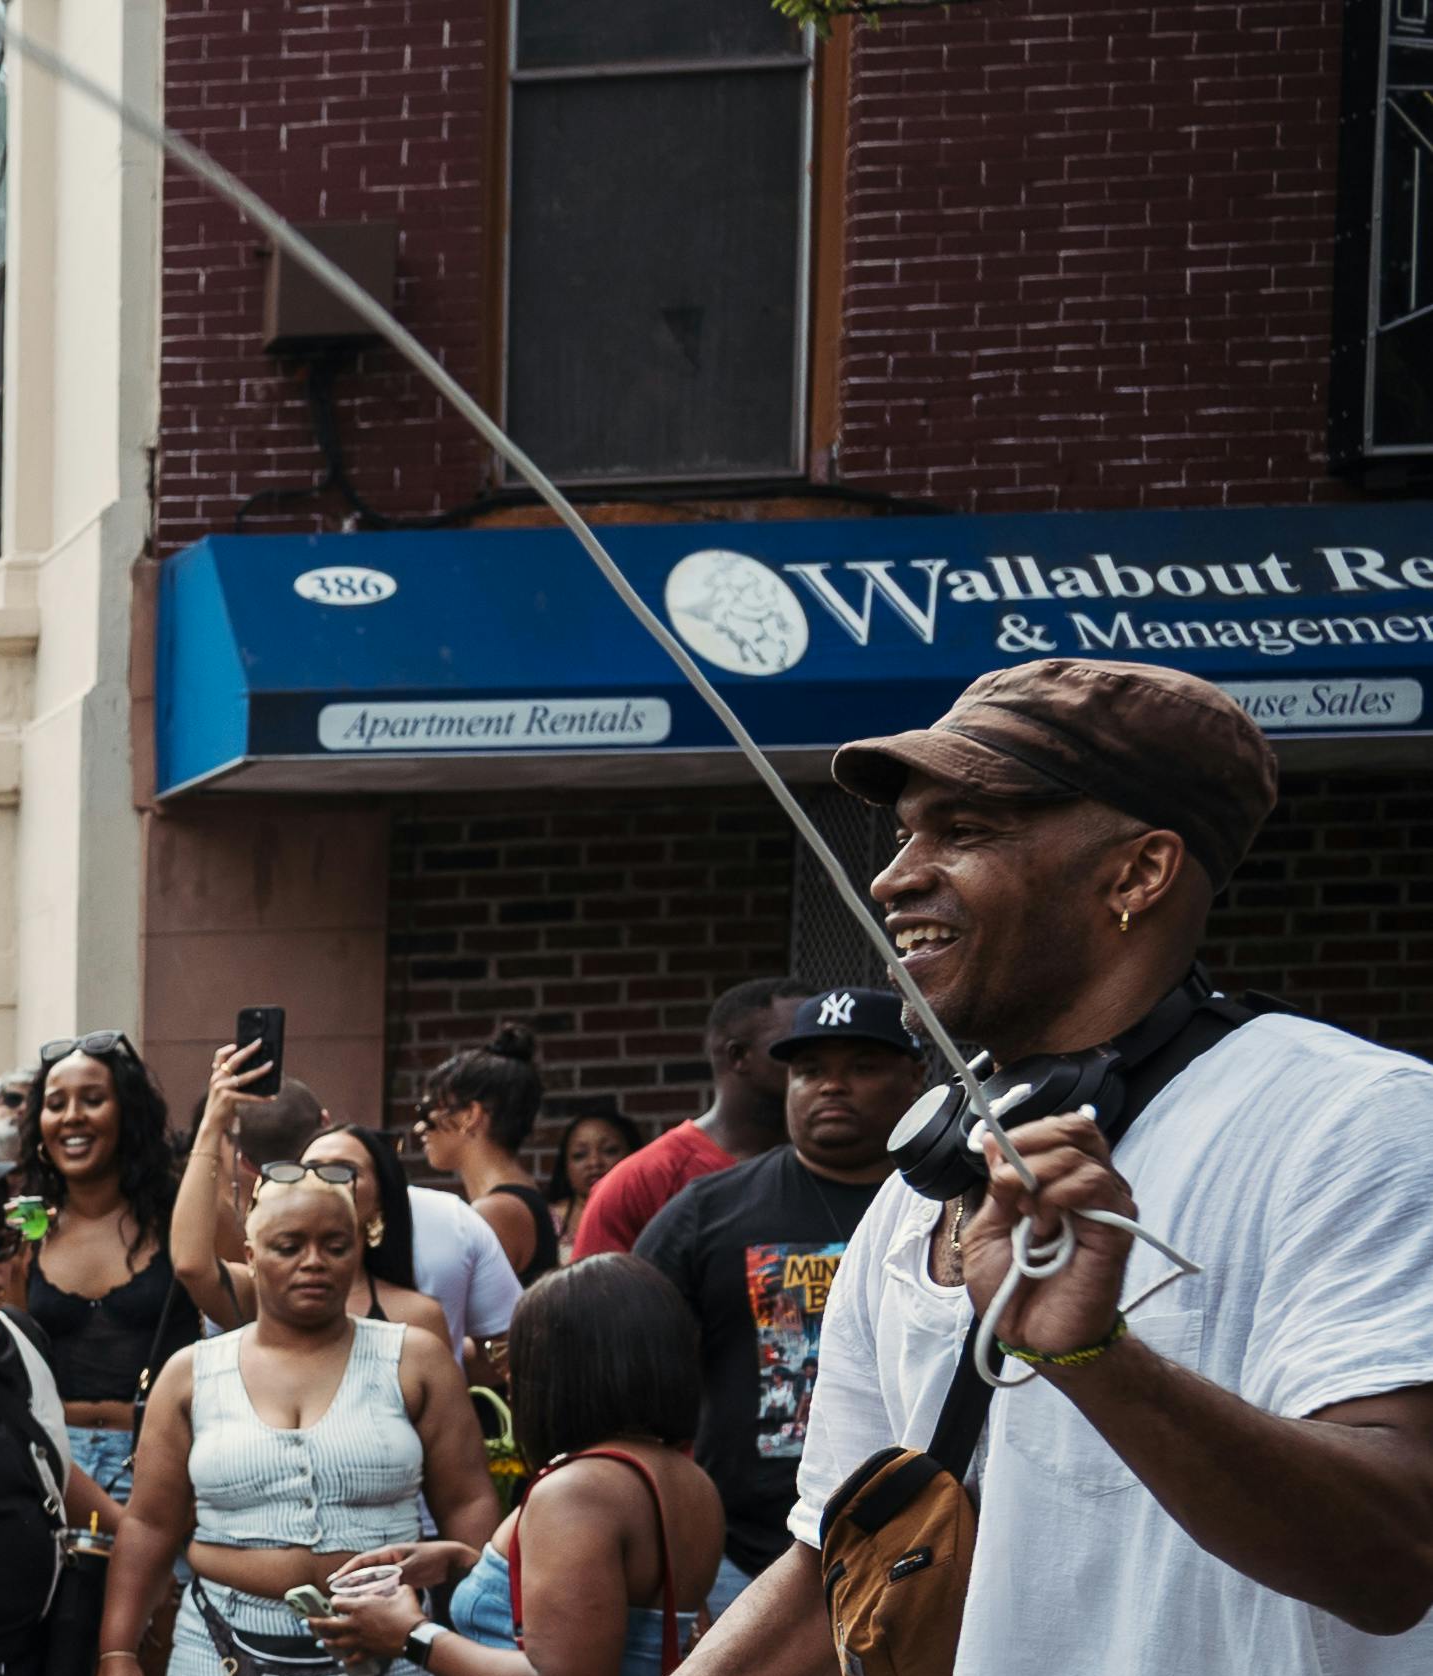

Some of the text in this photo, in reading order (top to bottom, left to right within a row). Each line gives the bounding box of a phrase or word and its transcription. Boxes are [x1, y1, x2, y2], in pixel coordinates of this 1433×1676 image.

[311, 574, 383, 600] 386
[782, 552, 1302, 647] Wallabout
[995, 612, 1057, 653] &
[1305, 682, 1396, 717] Sales
[343, 701, 646, 745] Apartment Rentals
[816, 991, 856, 1026] NY
